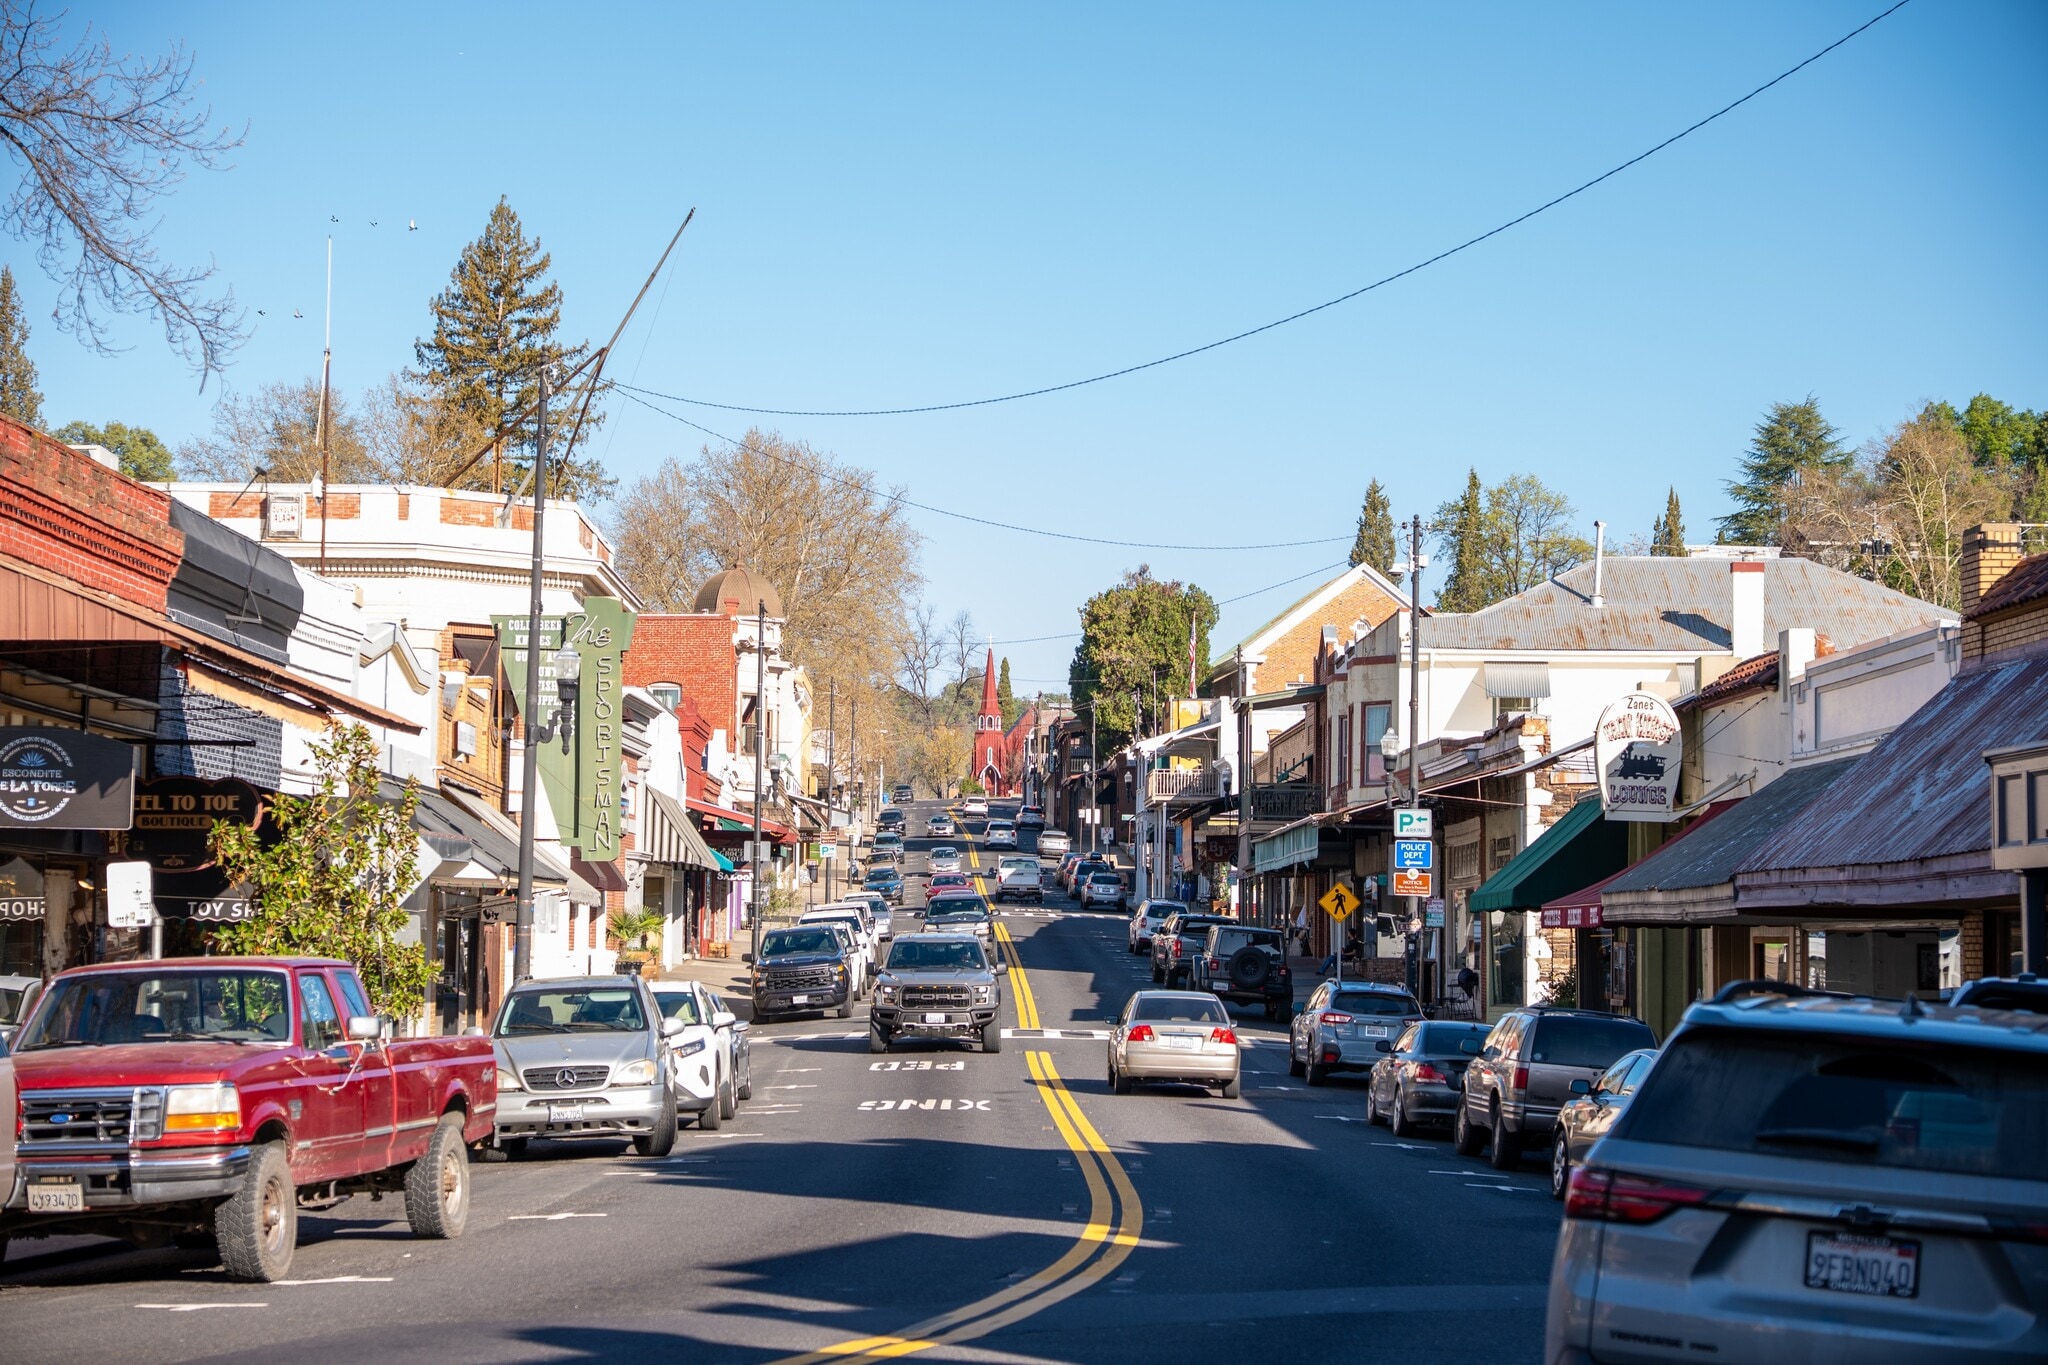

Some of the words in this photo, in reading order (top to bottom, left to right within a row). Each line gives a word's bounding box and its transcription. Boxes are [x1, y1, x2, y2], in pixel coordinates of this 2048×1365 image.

[567, 614, 612, 648] The
[515, 635, 551, 646] KNES
[590, 657, 613, 851] SPORTSMAN
[2, 768, 63, 778] ESCONDITE
[0, 781, 9, 791] E
[9, 780, 29, 793] LA
[30, 780, 76, 794] TORRE
[1610, 784, 1667, 805] LOUNGE
[168, 794, 196, 811] TO
[200, 794, 239, 811] TOE
[141, 816, 207, 827] BOUTIQUE
[1400, 843, 1427, 851] POLICE
[1403, 851, 1424, 859] DEPT.
[187, 902, 225, 916] TOY
[231, 903, 264, 917] SH
[32, 1193, 78, 1207] 4Y93470
[1830, 1281, 1889, 1296] CHEVROLET
